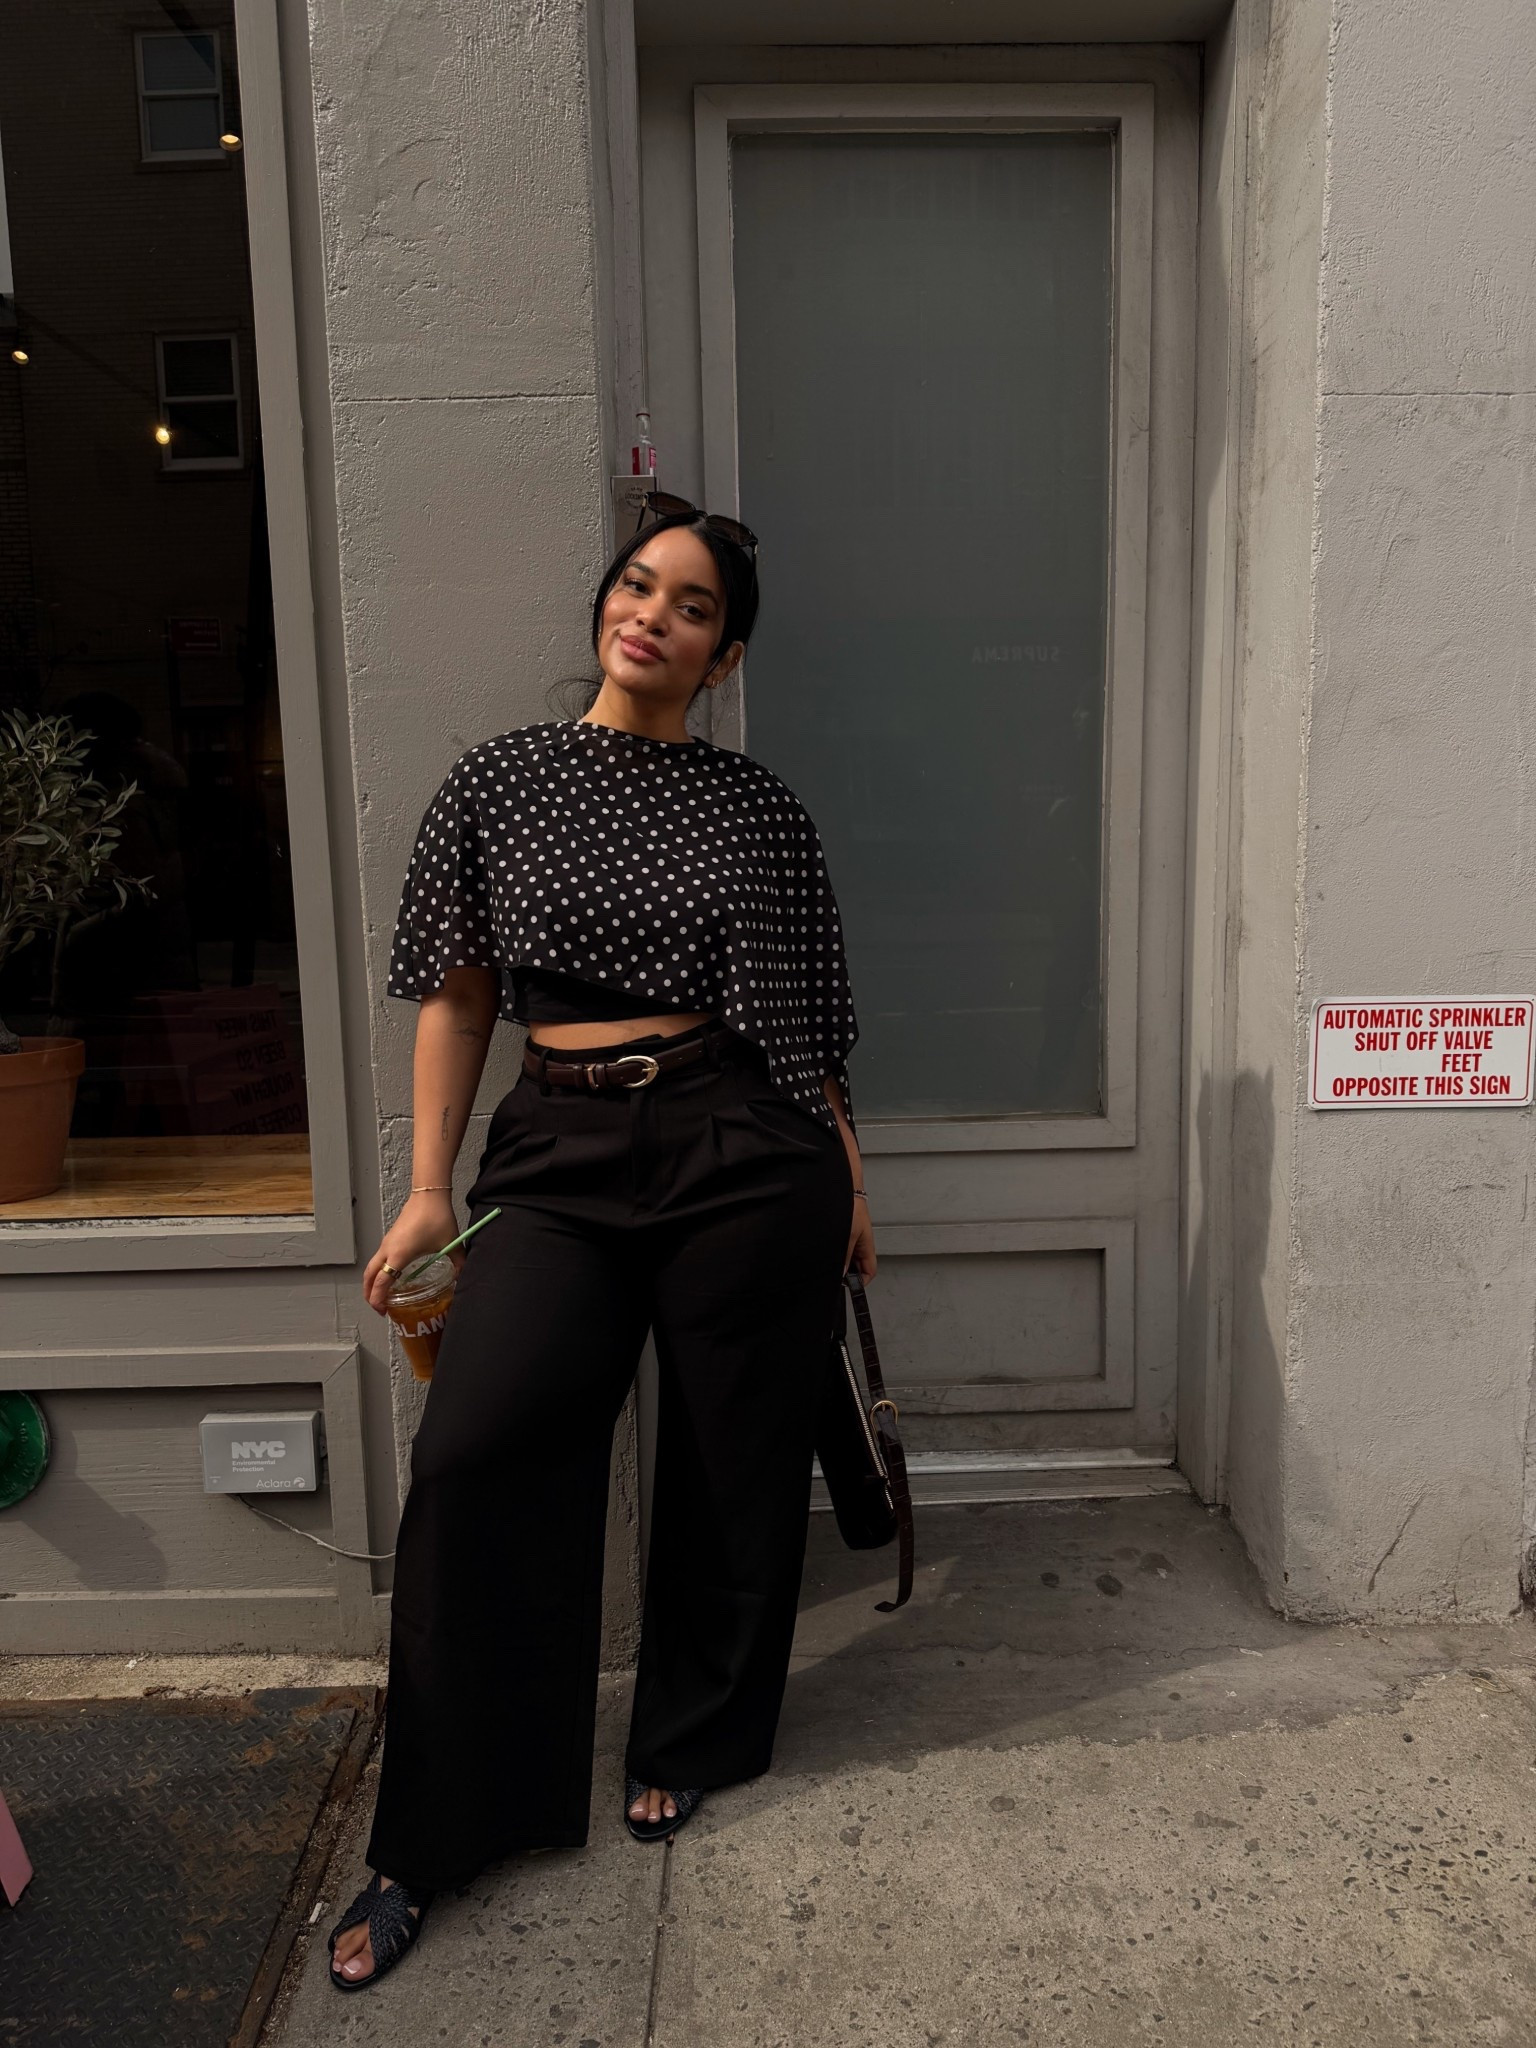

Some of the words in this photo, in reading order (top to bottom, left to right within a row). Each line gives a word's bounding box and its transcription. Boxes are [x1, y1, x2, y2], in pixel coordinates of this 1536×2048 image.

[1323, 1008, 1423, 1029] AUTOMATIC
[1428, 1007, 1526, 1027] SPRINKLER
[1354, 1032, 1401, 1051] SHUT
[1406, 1031, 1438, 1050] OFF
[1444, 1030, 1493, 1050] VALVE
[1441, 1053, 1482, 1073] FEET
[1332, 1076, 1418, 1097] OPPOSITE
[1424, 1075, 1464, 1096] THIS
[1469, 1075, 1511, 1095] SIGN
[231, 1441, 286, 1458] NYC
[256, 1480, 291, 1488] Aclara
